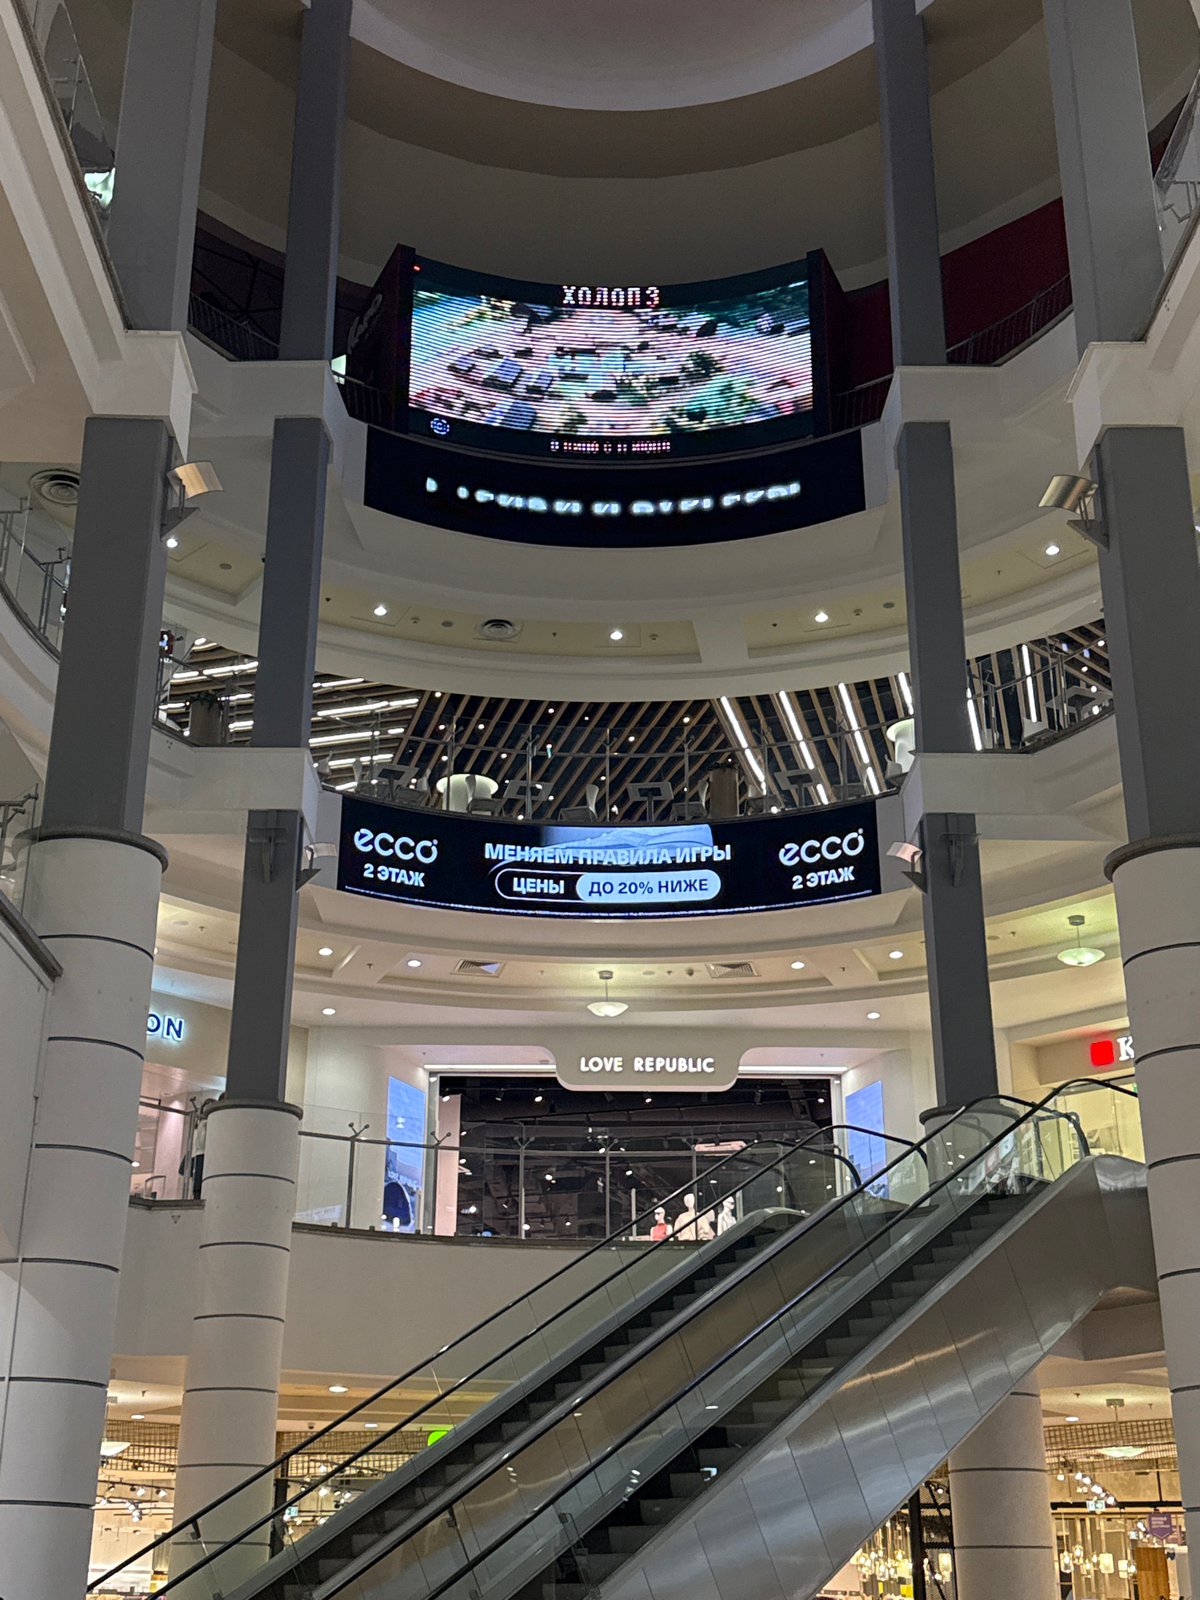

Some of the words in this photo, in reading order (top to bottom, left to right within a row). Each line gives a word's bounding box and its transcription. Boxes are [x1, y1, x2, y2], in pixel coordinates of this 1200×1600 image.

[562, 285, 641, 306] ХОЛОП
[645, 286, 660, 307] 3
[353, 828, 438, 864] ecco
[484, 842, 574, 865] МЕНЯЕМ
[579, 848, 673, 866] ПРАВИЛА
[675, 844, 732, 864] ИГРЫ
[779, 828, 865, 866] ecco
[363, 863, 375, 879] 2
[376, 865, 425, 887] ЭТАЖ
[512, 877, 565, 895] ЦЕНЫ
[588, 881, 614, 897] ДО
[618, 881, 654, 895] 20%
[657, 878, 709, 894] НИЖЕ
[792, 875, 804, 890] 2
[805, 865, 855, 888] ЭТАЖ
[579, 1056, 624, 1073] LOVE
[633, 1056, 715, 1073] REPUBLIC
